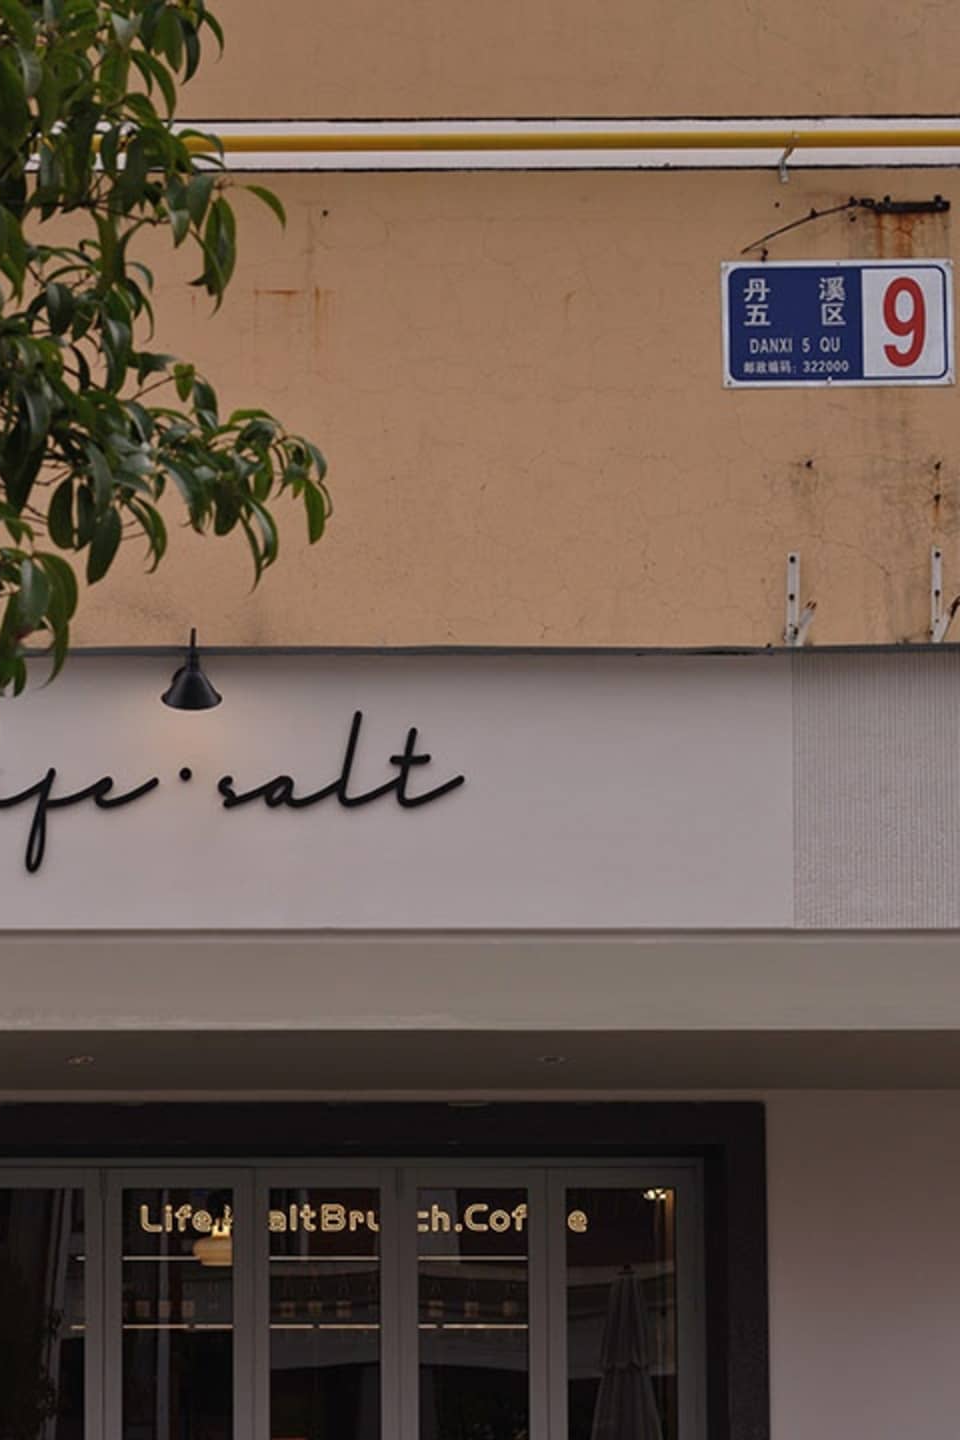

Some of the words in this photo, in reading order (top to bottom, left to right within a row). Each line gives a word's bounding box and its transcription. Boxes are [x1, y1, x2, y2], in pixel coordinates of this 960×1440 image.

[743, 277, 845, 302] 丹溪
[743, 303, 846, 326] 五区
[883, 276, 926, 369] 9
[749, 338, 793, 354] DANXI
[820, 336, 841, 353] QU
[802, 360, 849, 373] 322000
[217, 710, 465, 809] salt
